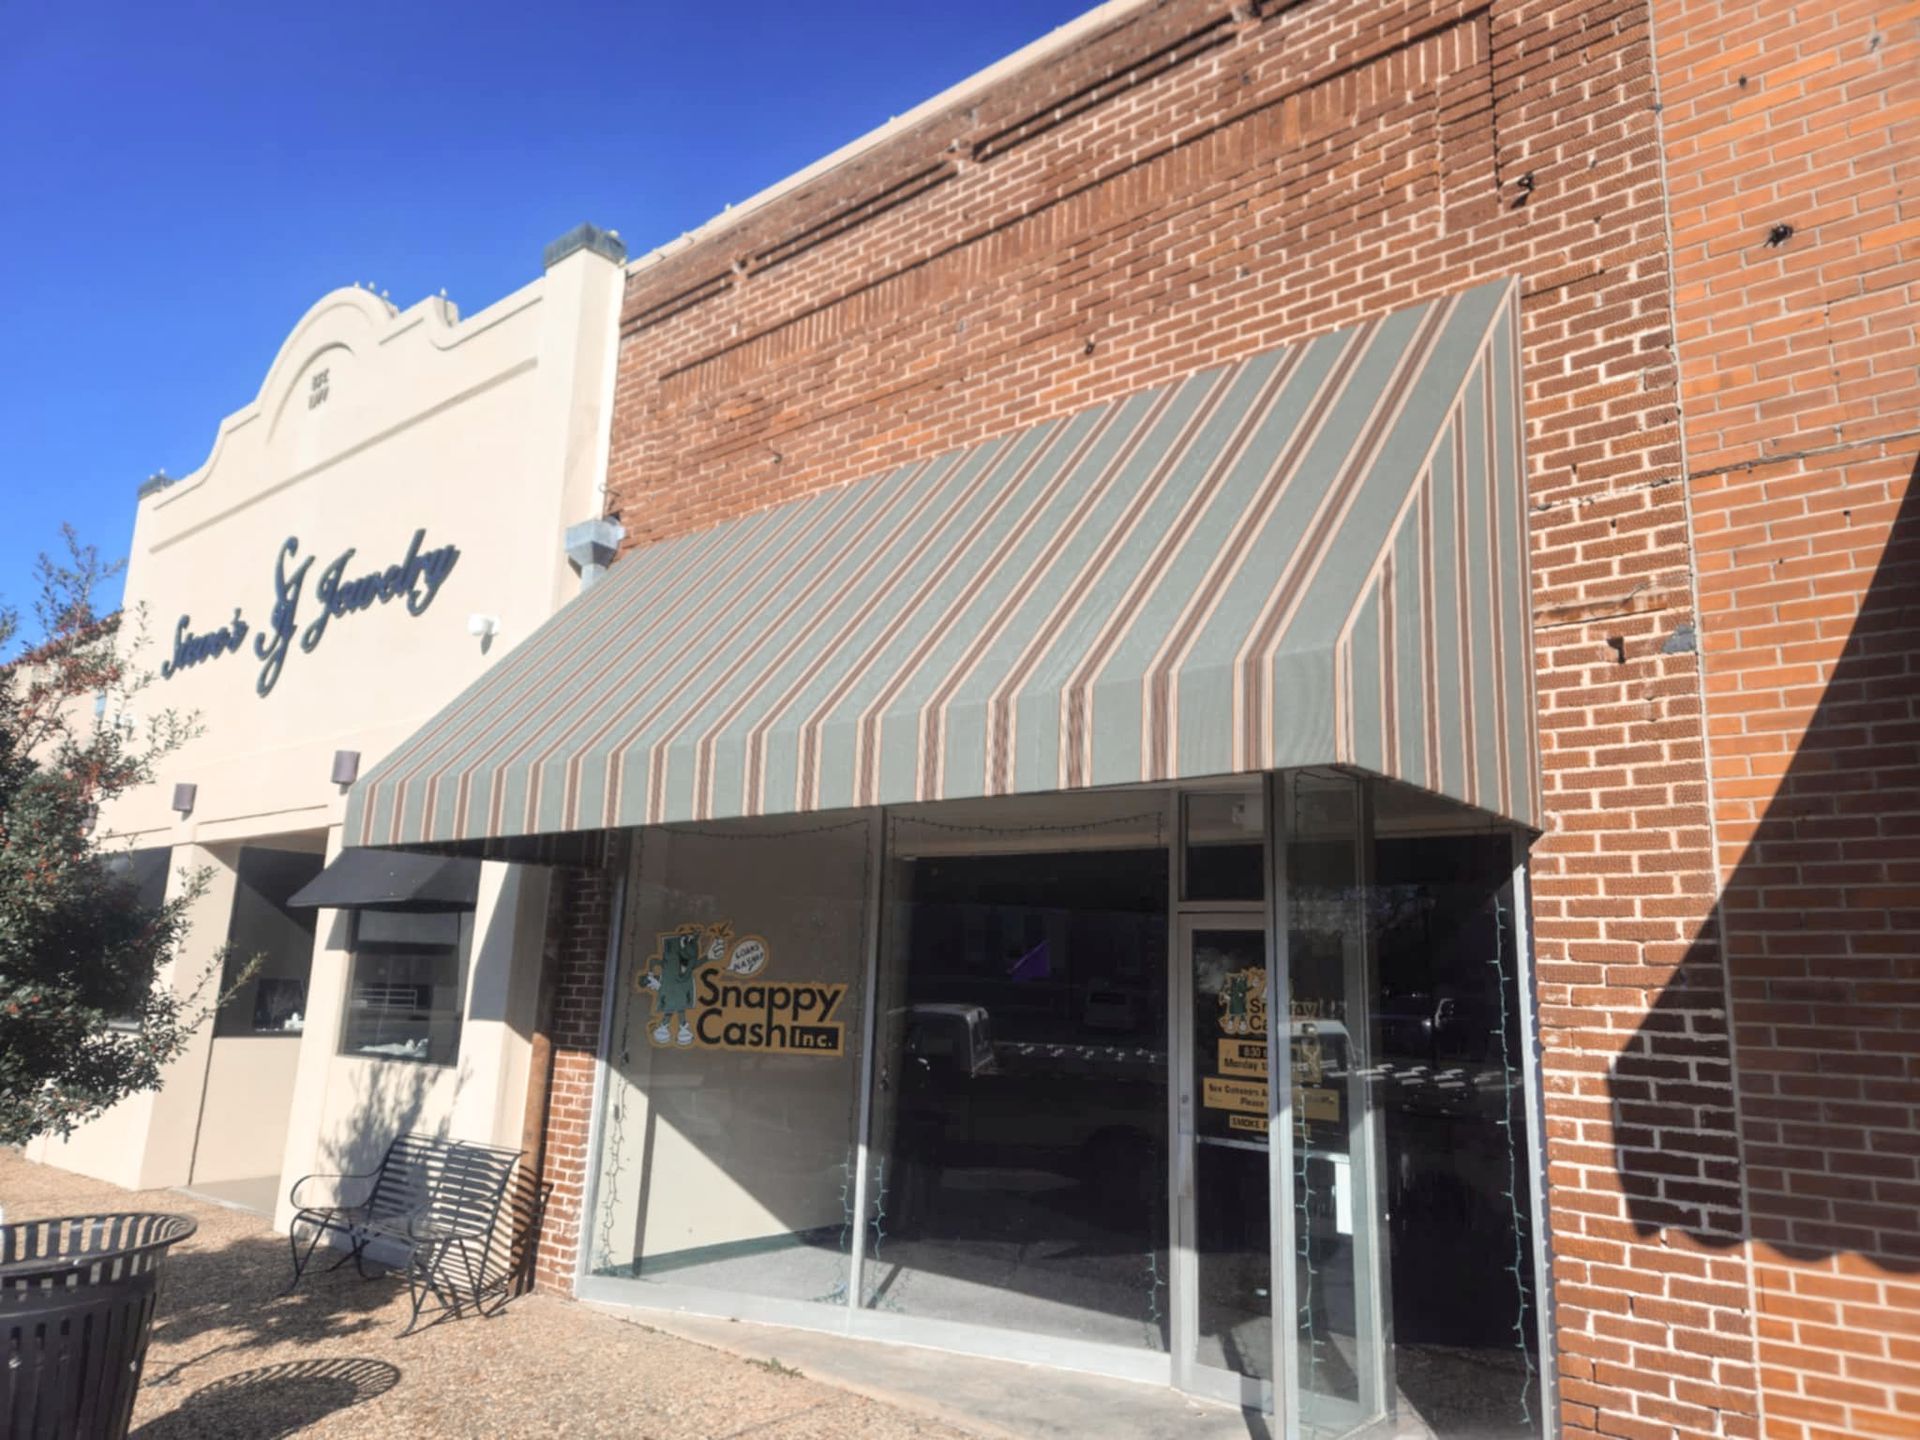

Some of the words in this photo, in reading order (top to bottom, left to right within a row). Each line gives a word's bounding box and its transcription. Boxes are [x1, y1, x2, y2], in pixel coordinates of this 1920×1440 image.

[300, 528, 461, 654] Jewelry
[697, 968, 841, 1023] Snappy
[696, 1008, 786, 1047] Cash
[794, 1030, 833, 1048] Inc.
[1224, 1057, 1258, 1072] Monday
[1232, 1117, 1260, 1128] SMOKE
